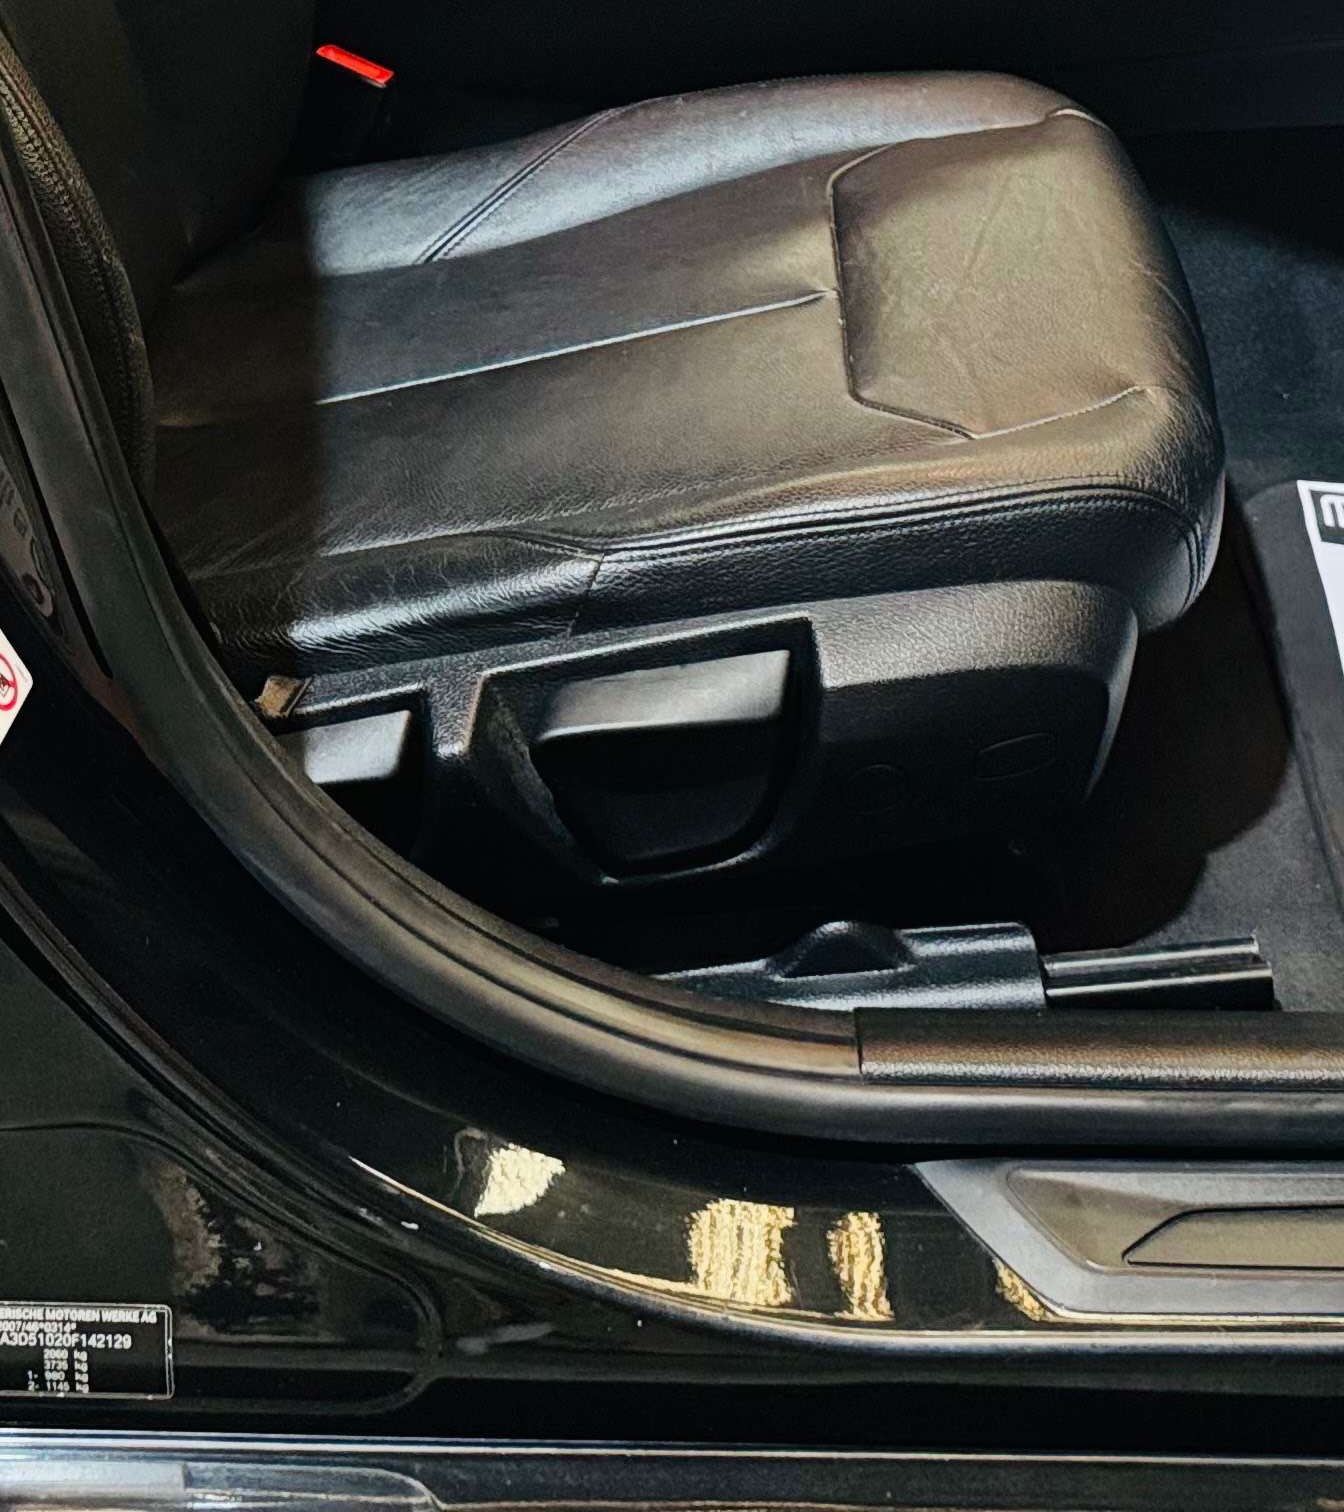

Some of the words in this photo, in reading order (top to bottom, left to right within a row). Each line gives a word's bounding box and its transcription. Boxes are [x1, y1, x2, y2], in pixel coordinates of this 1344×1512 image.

[45, 1309, 100, 1322] MOTOREN
[101, 1311, 140, 1323] WERKE
[141, 1312, 157, 1324] AG
[74, 1349, 88, 1362] kg
[74, 1361, 88, 1373] kg
[74, 1371, 89, 1383] kg
